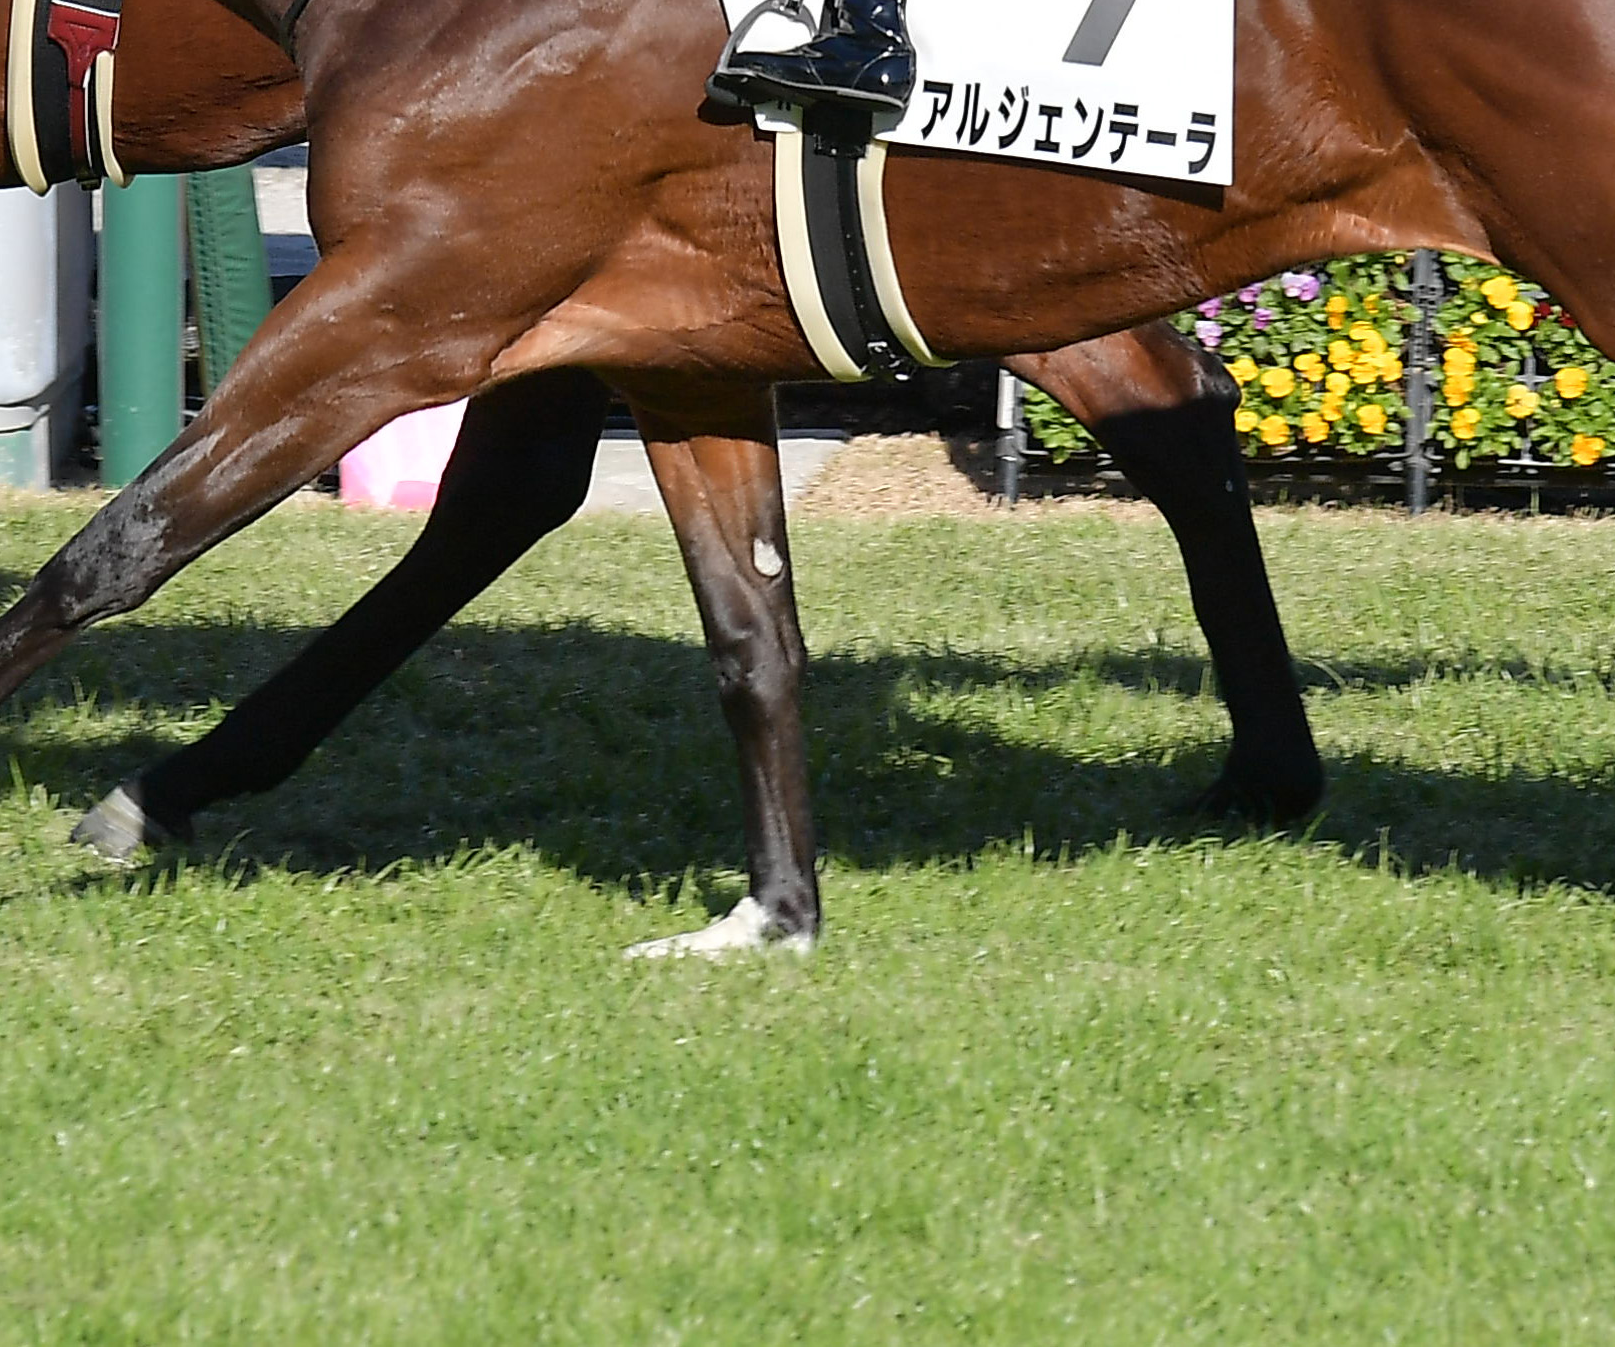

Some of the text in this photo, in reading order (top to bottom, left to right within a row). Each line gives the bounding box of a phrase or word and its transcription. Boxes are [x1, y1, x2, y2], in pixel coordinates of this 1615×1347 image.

[920, 79, 1217, 175] アルジェンテーラ
